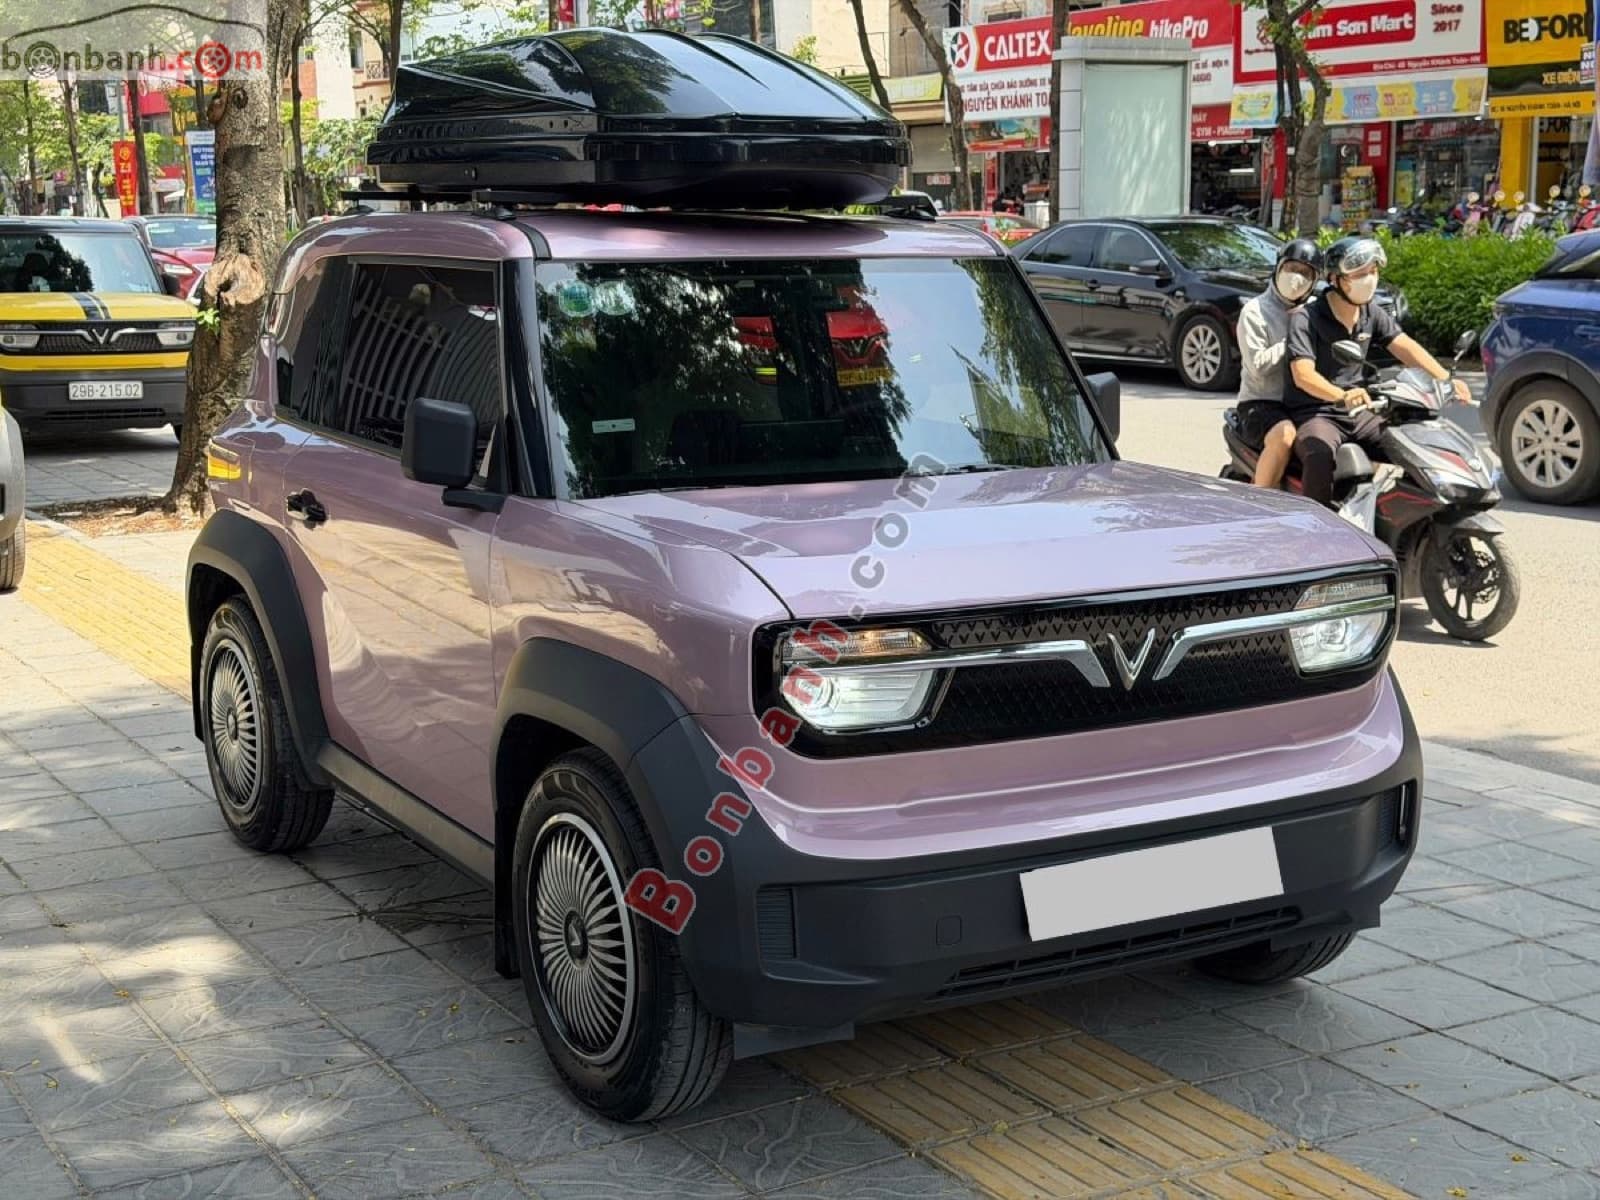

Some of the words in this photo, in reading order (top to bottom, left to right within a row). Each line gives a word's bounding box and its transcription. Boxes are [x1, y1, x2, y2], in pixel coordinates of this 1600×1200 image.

[1430, 3, 1464, 16] Since
[1371, 13, 1414, 33] Mart
[1433, 20, 1461, 33] 2017
[983, 29, 1052, 62] CALTEX
